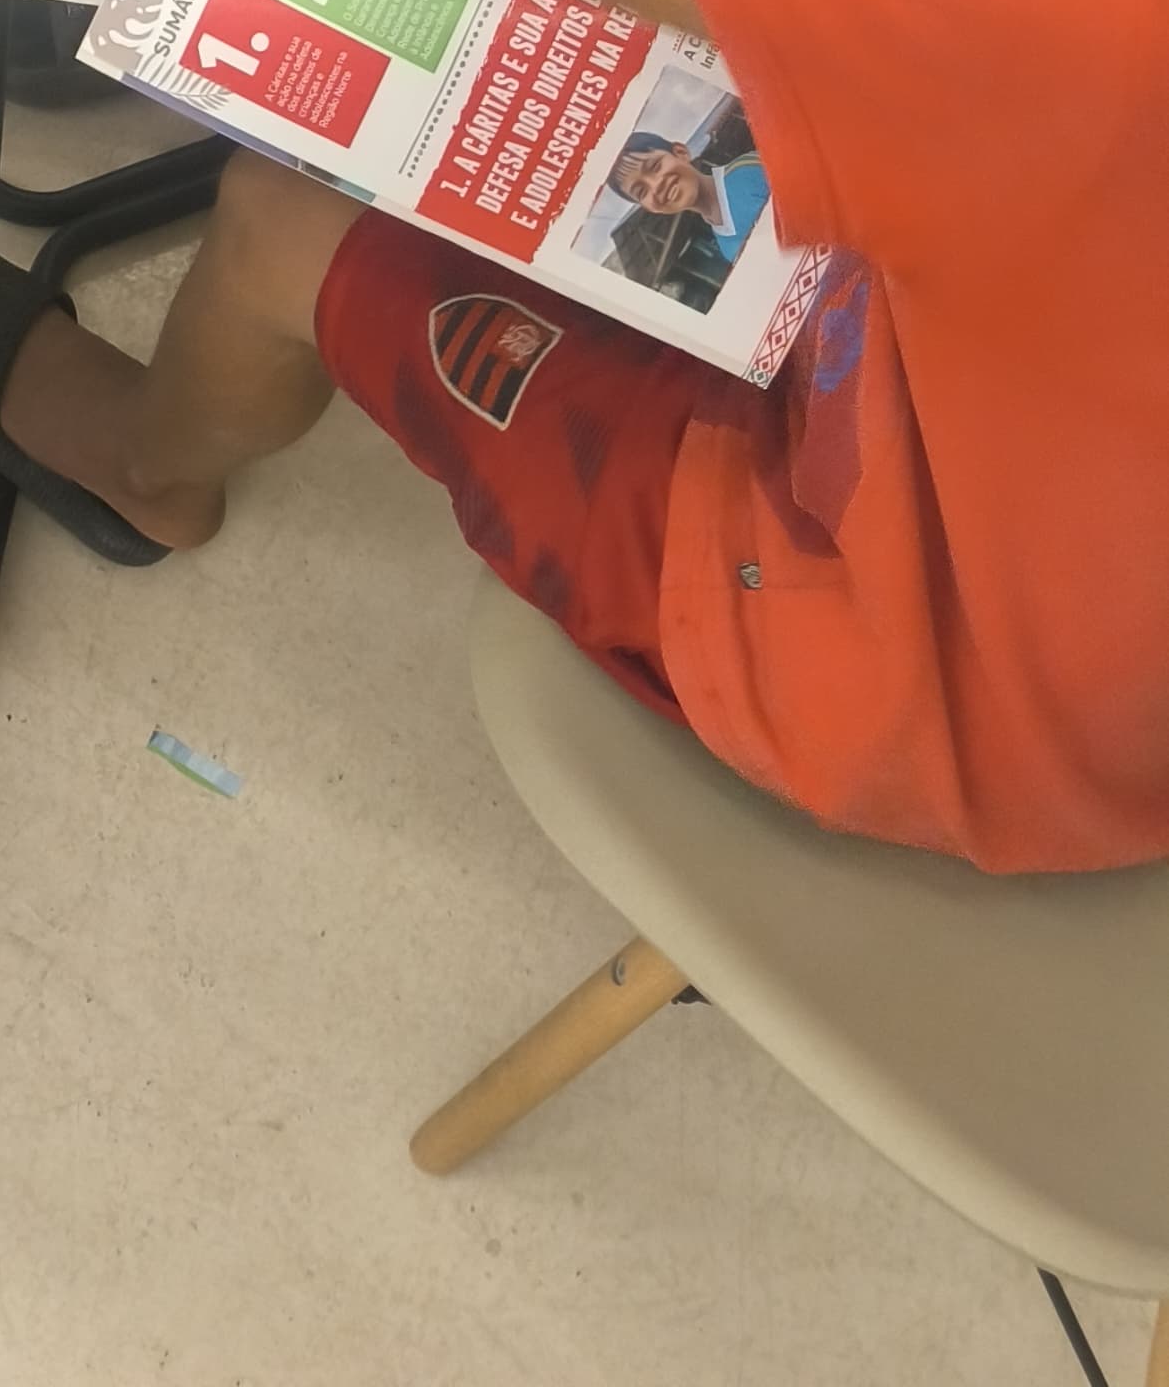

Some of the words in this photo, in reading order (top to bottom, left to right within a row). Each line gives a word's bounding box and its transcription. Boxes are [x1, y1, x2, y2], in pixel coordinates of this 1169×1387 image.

[285, 33, 303, 55] sua
[505, 6, 551, 58] SUA
[197, 32, 271, 77] 1.
[288, 37, 314, 73] defesa
[307, 44, 324, 63] de
[498, 51, 530, 75] E
[526, 1, 599, 103] DIREITOS
[586, 35, 625, 73] NA
[272, 81, 294, 109] ação
[283, 69, 299, 85] na
[290, 58, 318, 96] direitos
[304, 62, 345, 126] adolescentes
[335, 48, 350, 65] na
[282, 92, 302, 114] dos
[294, 82, 322, 120] crianças
[316, 95, 343, 131] Região
[331, 67, 355, 99] Norte
[455, 67, 523, 158] CÁRITAS
[509, 94, 553, 144] DOS
[515, 67, 611, 216] ADOLESCENTES
[450, 151, 482, 177] A
[473, 135, 533, 216] DEFESA
[438, 168, 474, 200] 1.
[509, 209, 540, 232] E
